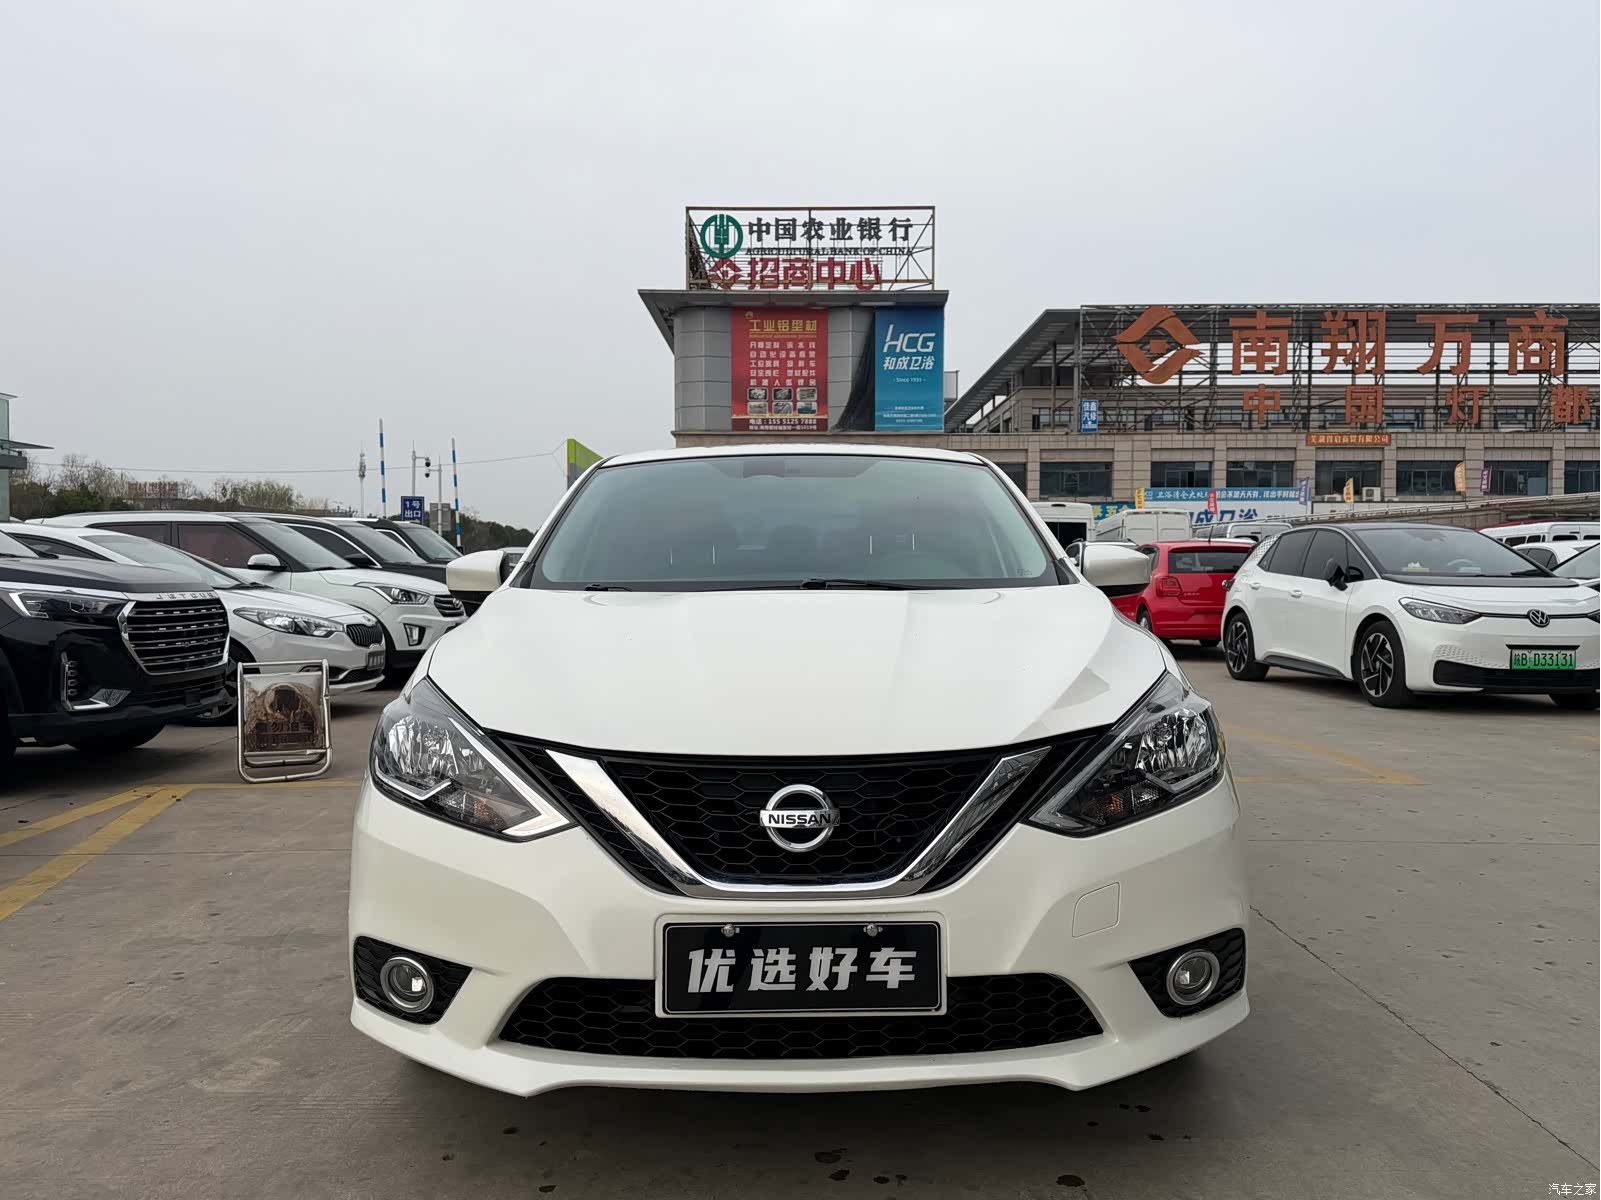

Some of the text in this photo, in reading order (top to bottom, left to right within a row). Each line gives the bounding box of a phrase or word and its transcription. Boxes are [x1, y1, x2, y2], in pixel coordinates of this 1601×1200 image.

[748, 217, 913, 242] 中国农业银行
[745, 247, 912, 256] AGRICULTURAL BANK OF CHINA
[747, 257, 882, 291] 招商中心
[749, 319, 817, 332] 工业铝型材
[883, 324, 936, 353] HCG
[1229, 309, 1568, 376] 南翔万商
[883, 356, 935, 370] 和成卫浴
[1243, 384, 1591, 425] 中国灯都
[405, 500, 421, 509] 1号
[404, 510, 421, 518] 出口
[1533, 653, 1573, 667] D33131
[768, 813, 832, 825] NISSAN
[687, 947, 917, 993] 优选好车
